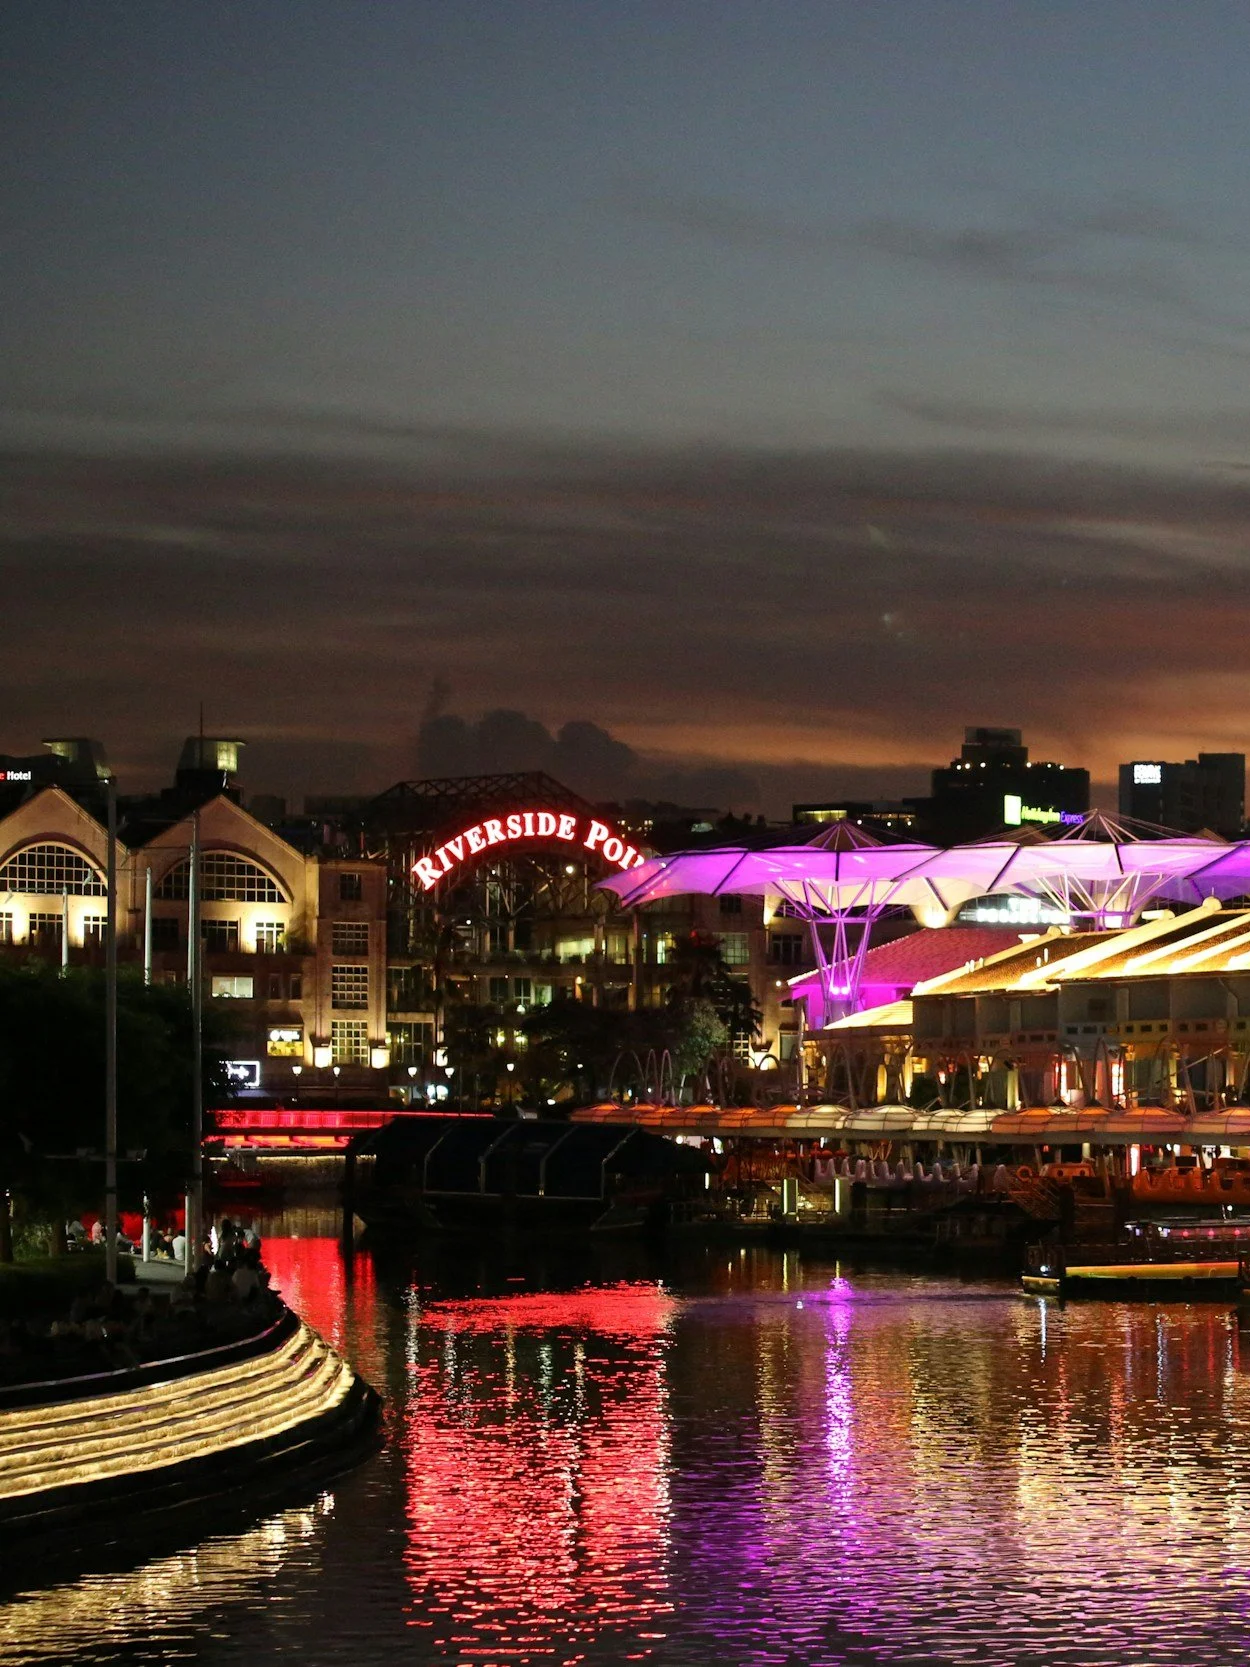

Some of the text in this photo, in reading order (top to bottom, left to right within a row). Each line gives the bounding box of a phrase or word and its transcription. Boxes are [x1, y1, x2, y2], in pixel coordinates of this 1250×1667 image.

[6, 770, 32, 780] Hotel
[1060, 811, 1083, 824] Express
[411, 812, 577, 890] RIVERSIDE
